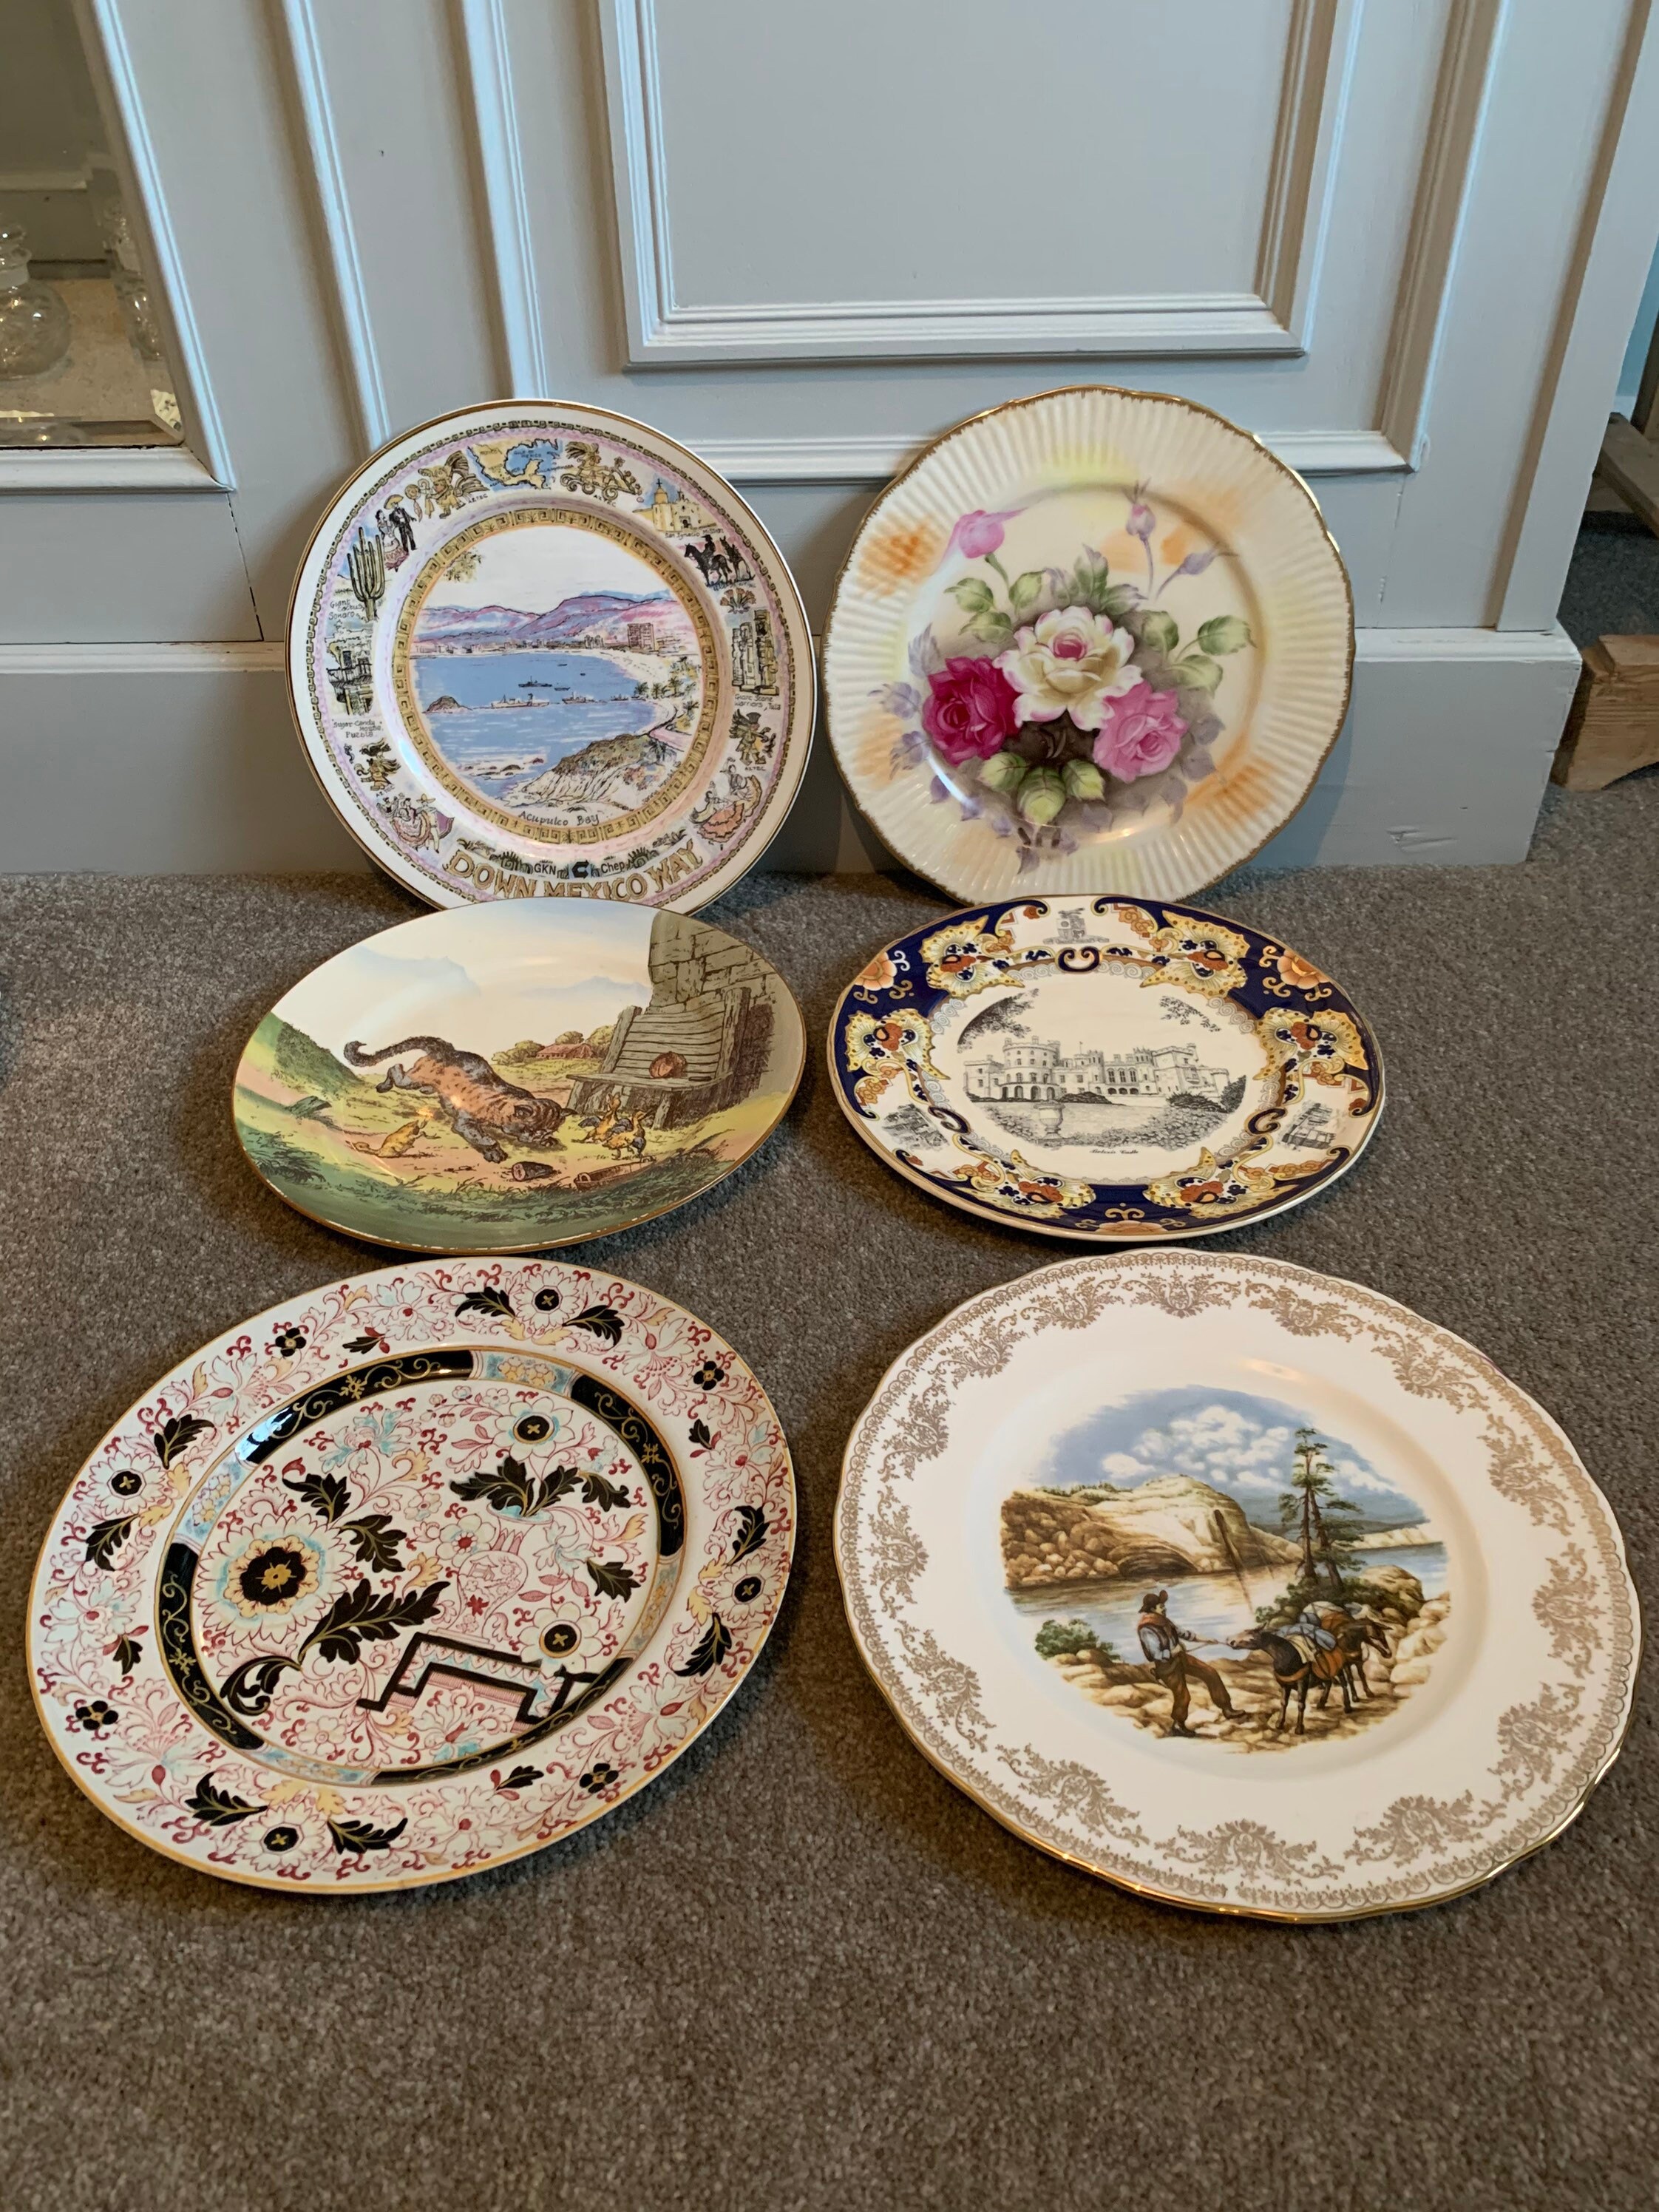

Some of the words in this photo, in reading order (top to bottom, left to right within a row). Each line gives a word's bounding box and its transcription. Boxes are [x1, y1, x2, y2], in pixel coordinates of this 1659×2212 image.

[577, 815, 600, 827] Bay
[443, 849, 538, 899] DOWN
[543, 873, 648, 901] MEXICO
[642, 838, 703, 893] WAY
[534, 863, 557, 875] GKN
[600, 861, 625, 874] Chep
